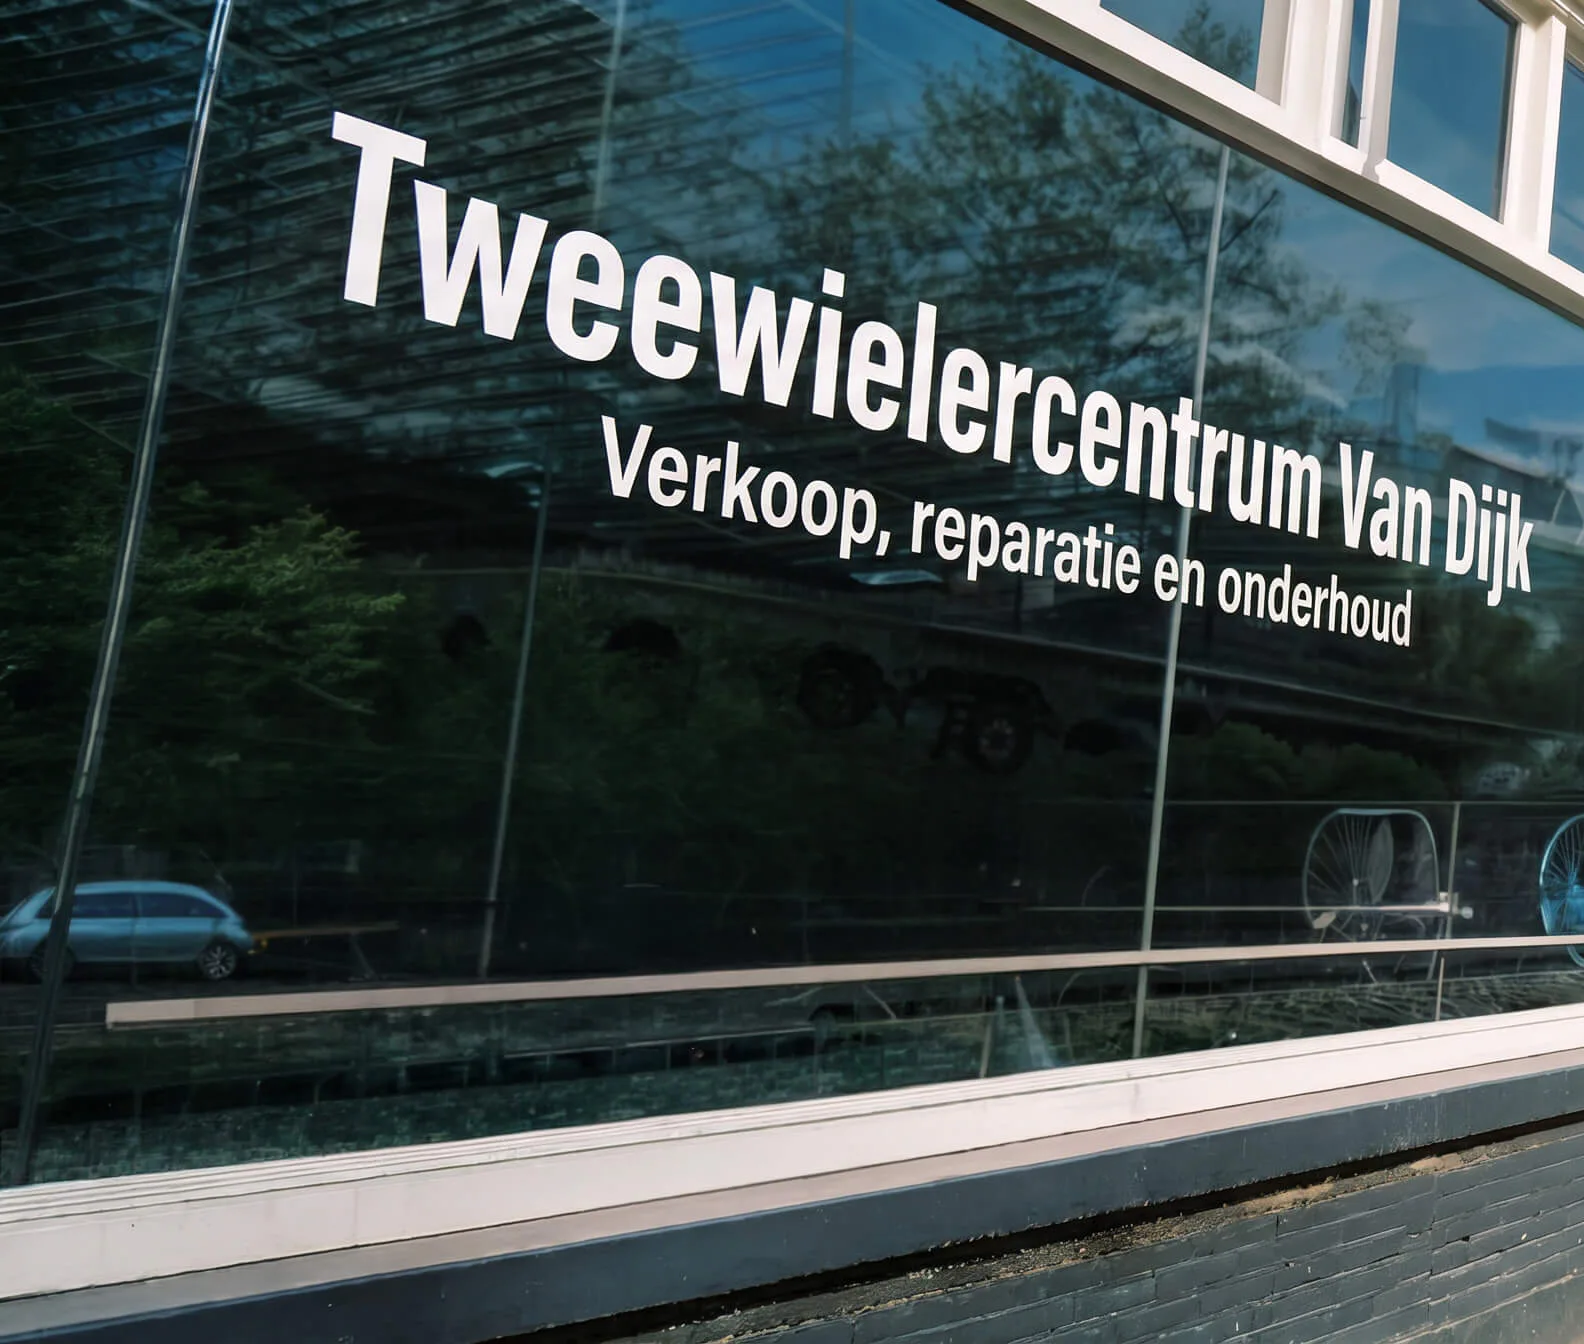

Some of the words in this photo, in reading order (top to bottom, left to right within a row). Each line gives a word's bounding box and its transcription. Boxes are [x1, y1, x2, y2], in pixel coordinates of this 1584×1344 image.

[331, 111, 1322, 539] Tweewielercentrum
[1339, 442, 1433, 567] Van
[1444, 477, 1535, 607] Dijk
[601, 415, 891, 560] Verkoop,
[911, 501, 1141, 594] reparatie
[1154, 553, 1205, 607] en
[1218, 563, 1412, 647] onderhoud
